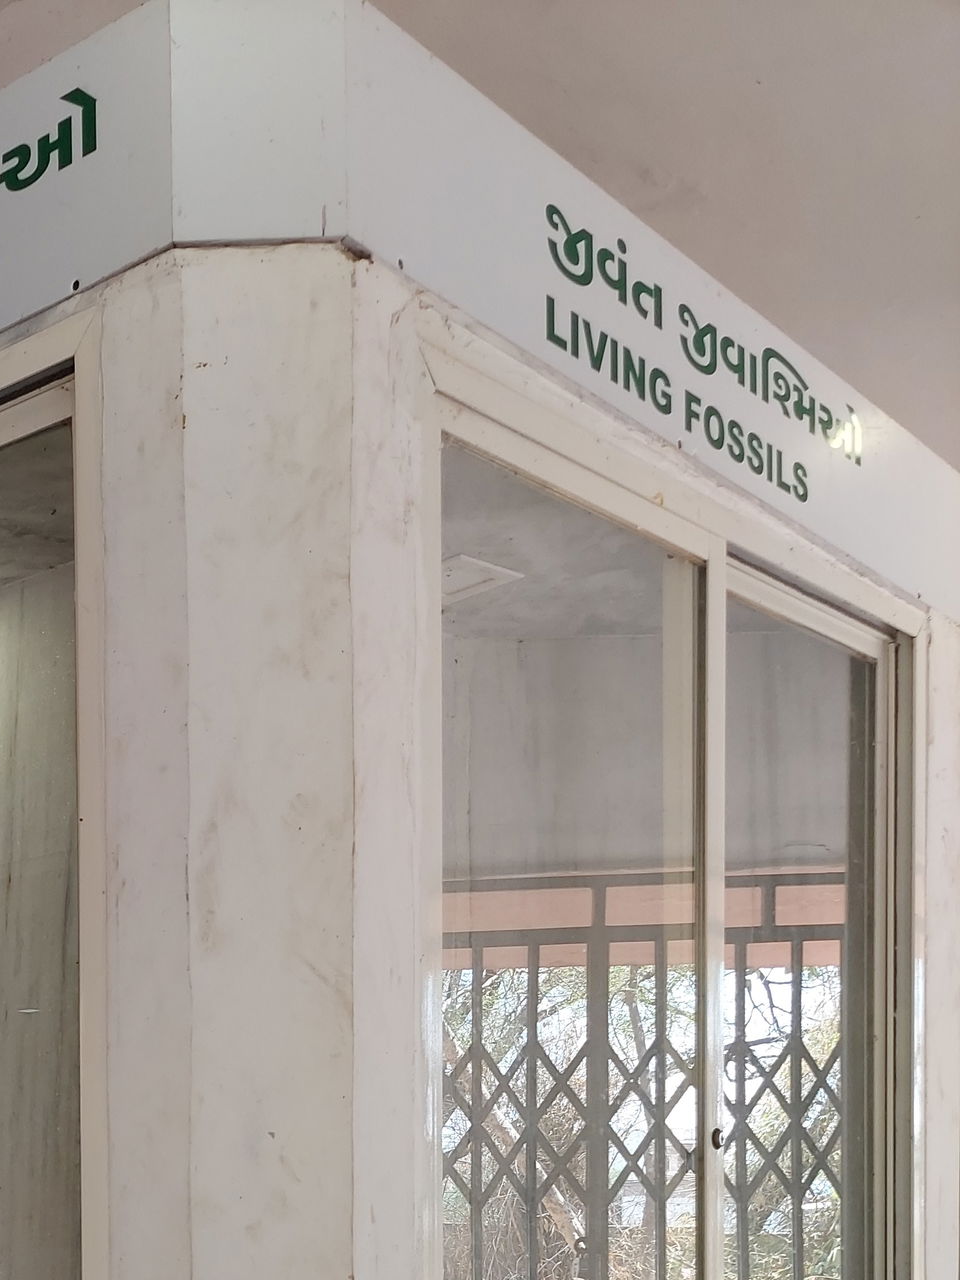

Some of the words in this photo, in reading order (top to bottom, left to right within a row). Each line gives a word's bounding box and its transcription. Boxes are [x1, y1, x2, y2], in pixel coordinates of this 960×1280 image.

[545, 203, 663, 330] જીવંત
[546, 294, 672, 416] LIVING
[684, 390, 809, 503] FOSSILS
